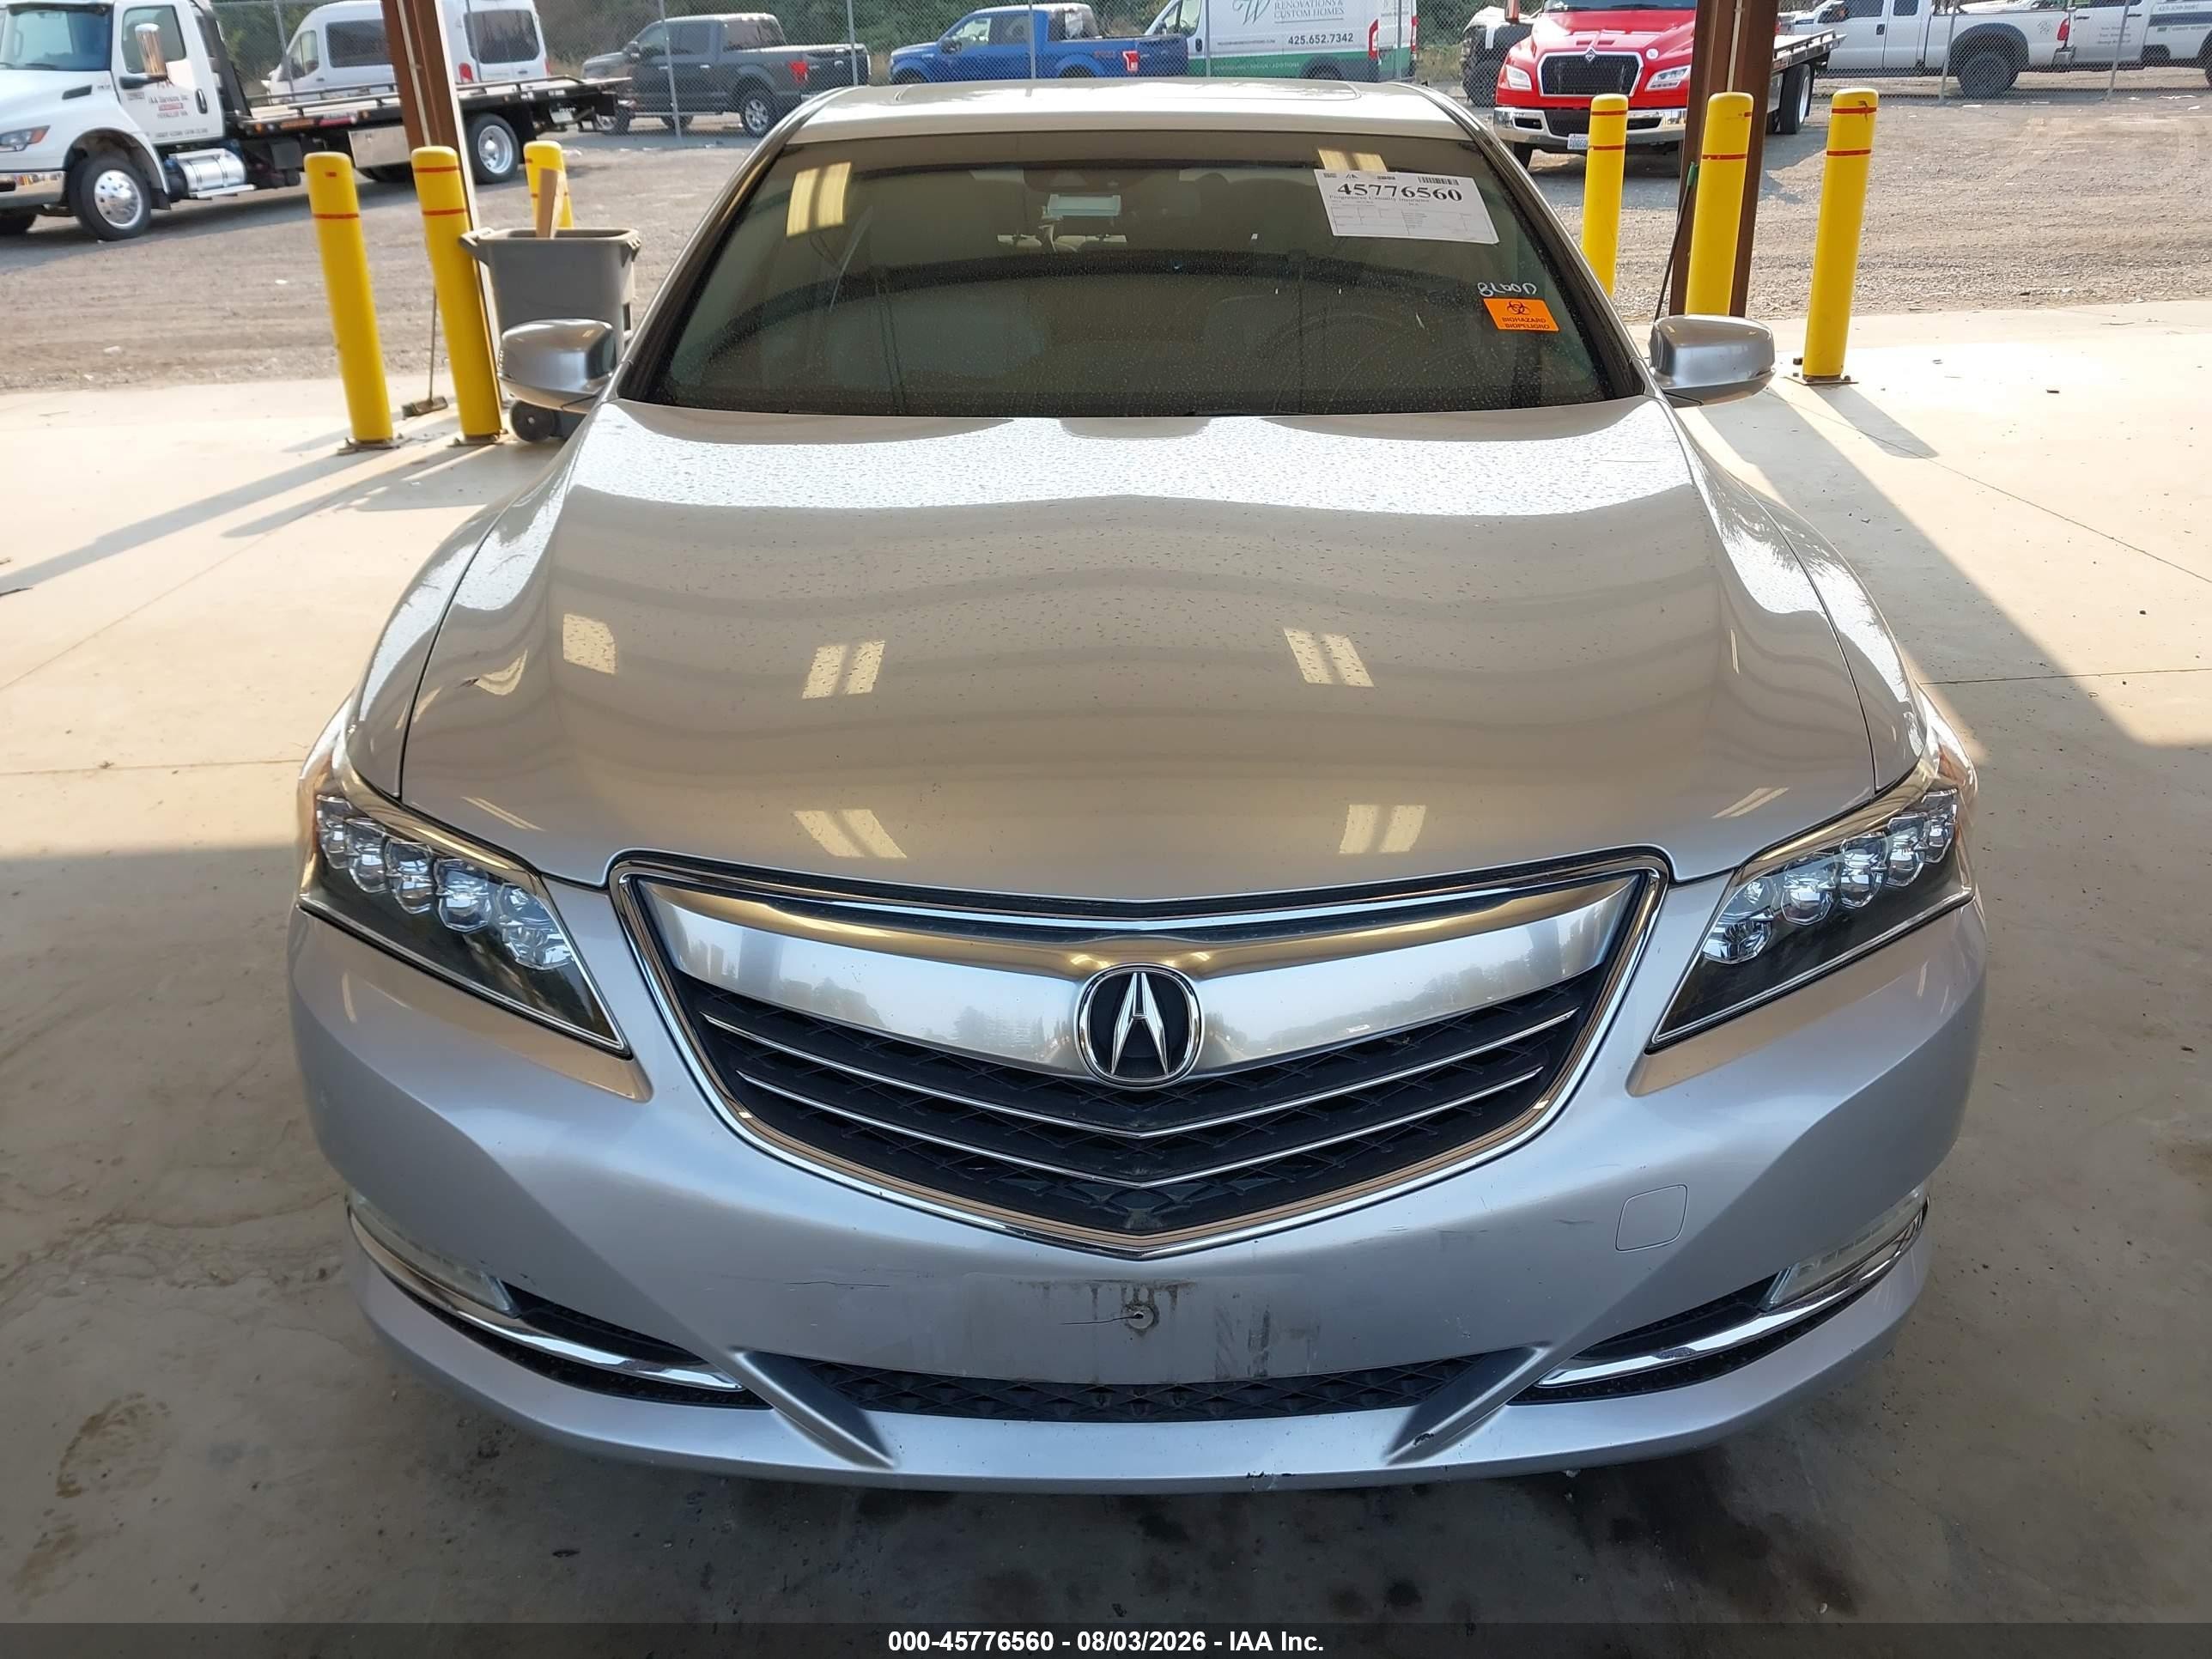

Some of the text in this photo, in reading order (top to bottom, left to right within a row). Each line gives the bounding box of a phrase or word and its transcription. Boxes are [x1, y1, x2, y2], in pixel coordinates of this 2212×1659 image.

[1274, 7, 1345, 18] CUSTOM HOMES
[1288, 33, 1354, 46] 425.652.7342
[1337, 183, 1462, 202] 45776560
